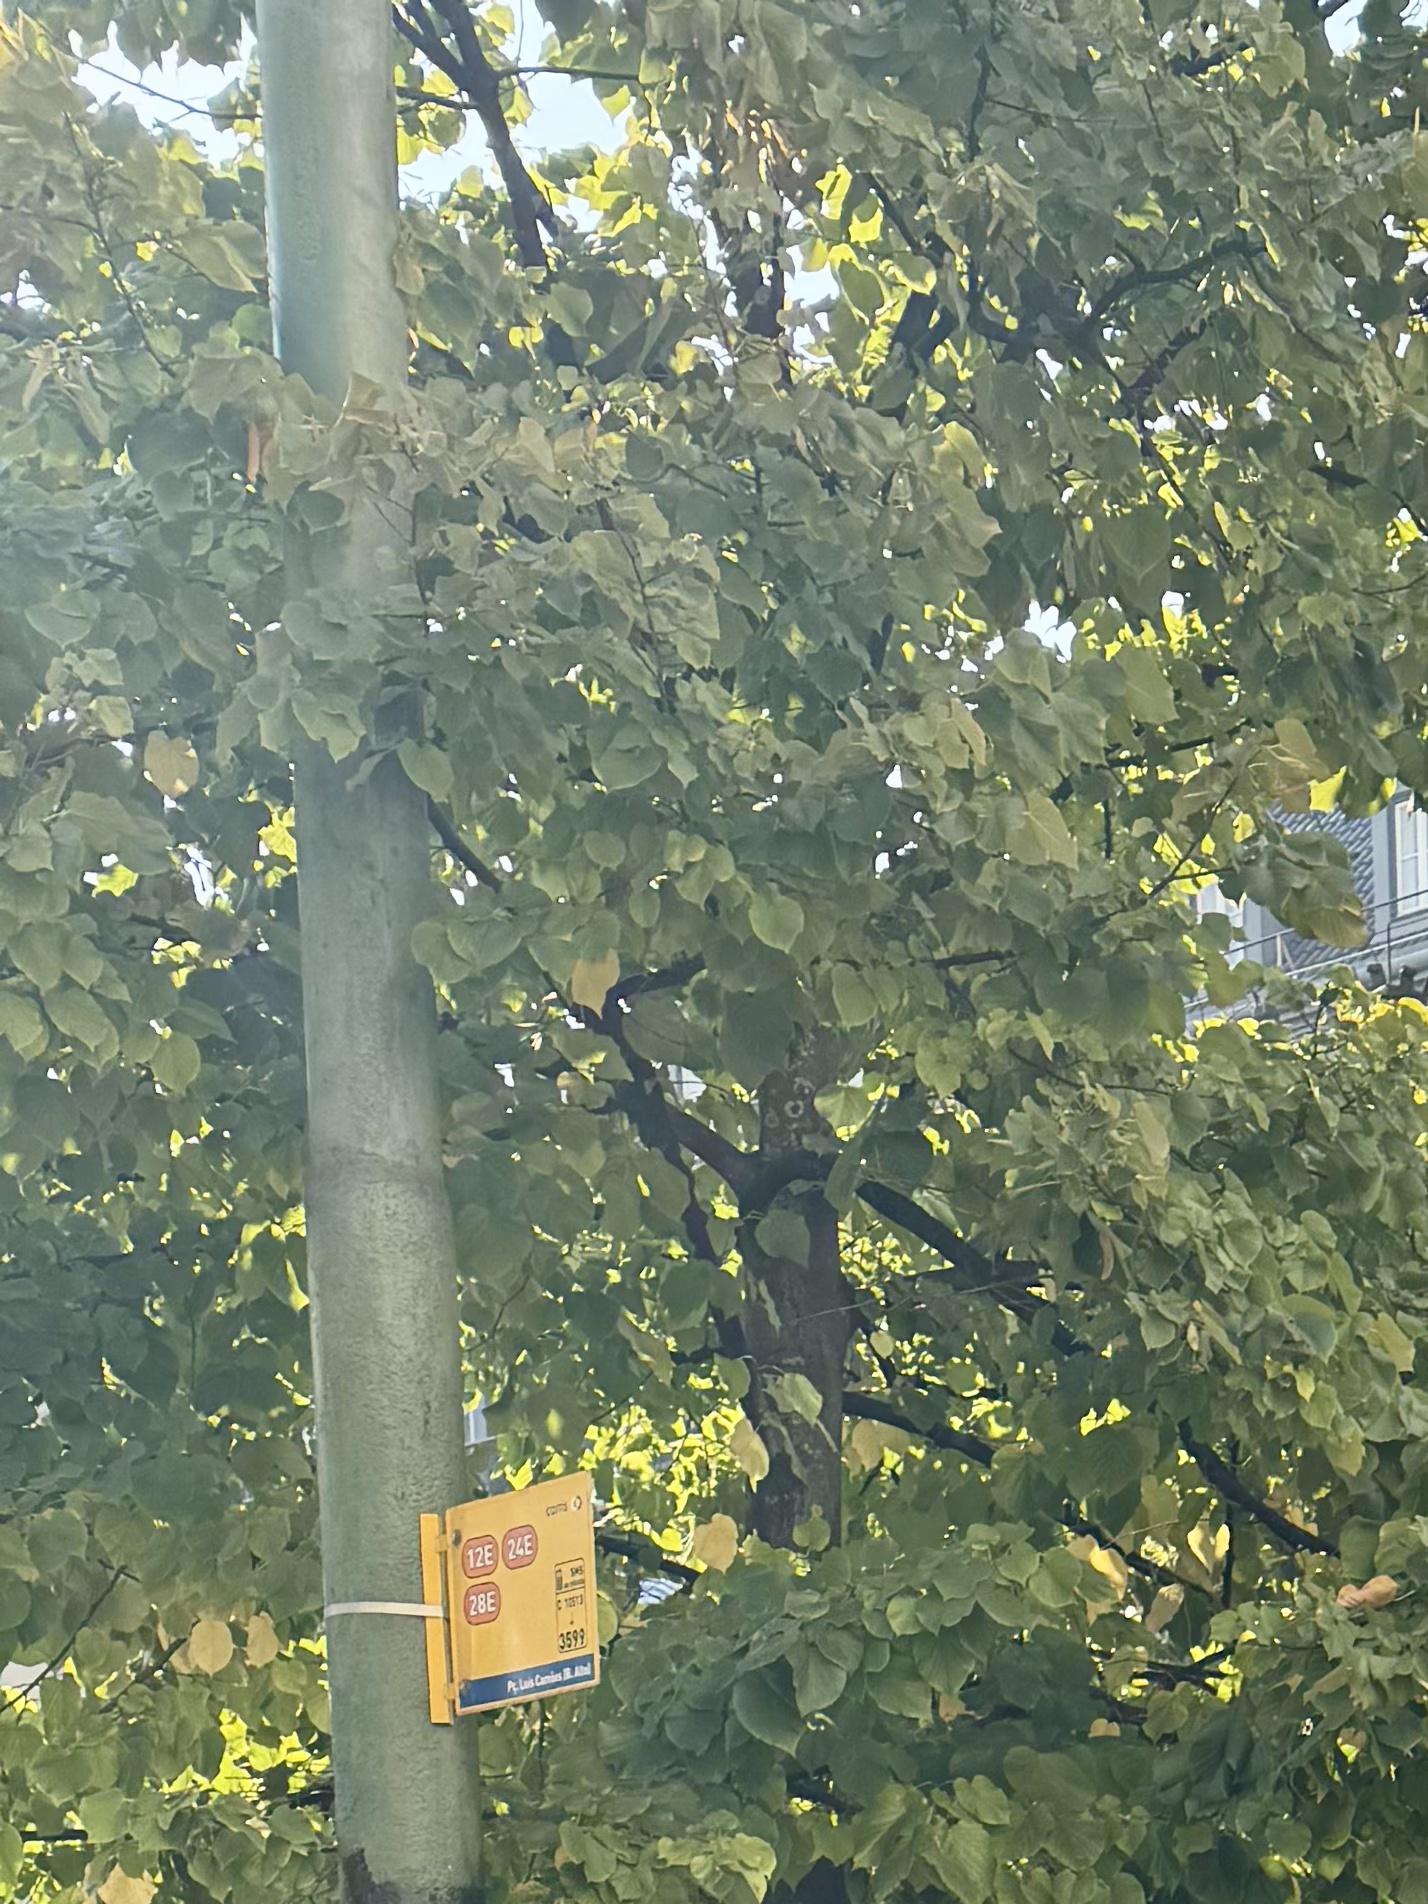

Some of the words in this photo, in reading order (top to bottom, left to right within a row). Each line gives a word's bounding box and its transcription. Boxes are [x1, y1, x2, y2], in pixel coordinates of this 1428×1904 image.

[467, 1544, 494, 1570] 12E
[507, 1534, 534, 1561] 24E
[469, 1591, 497, 1617] 28E
[559, 1628, 586, 1651] 3599
